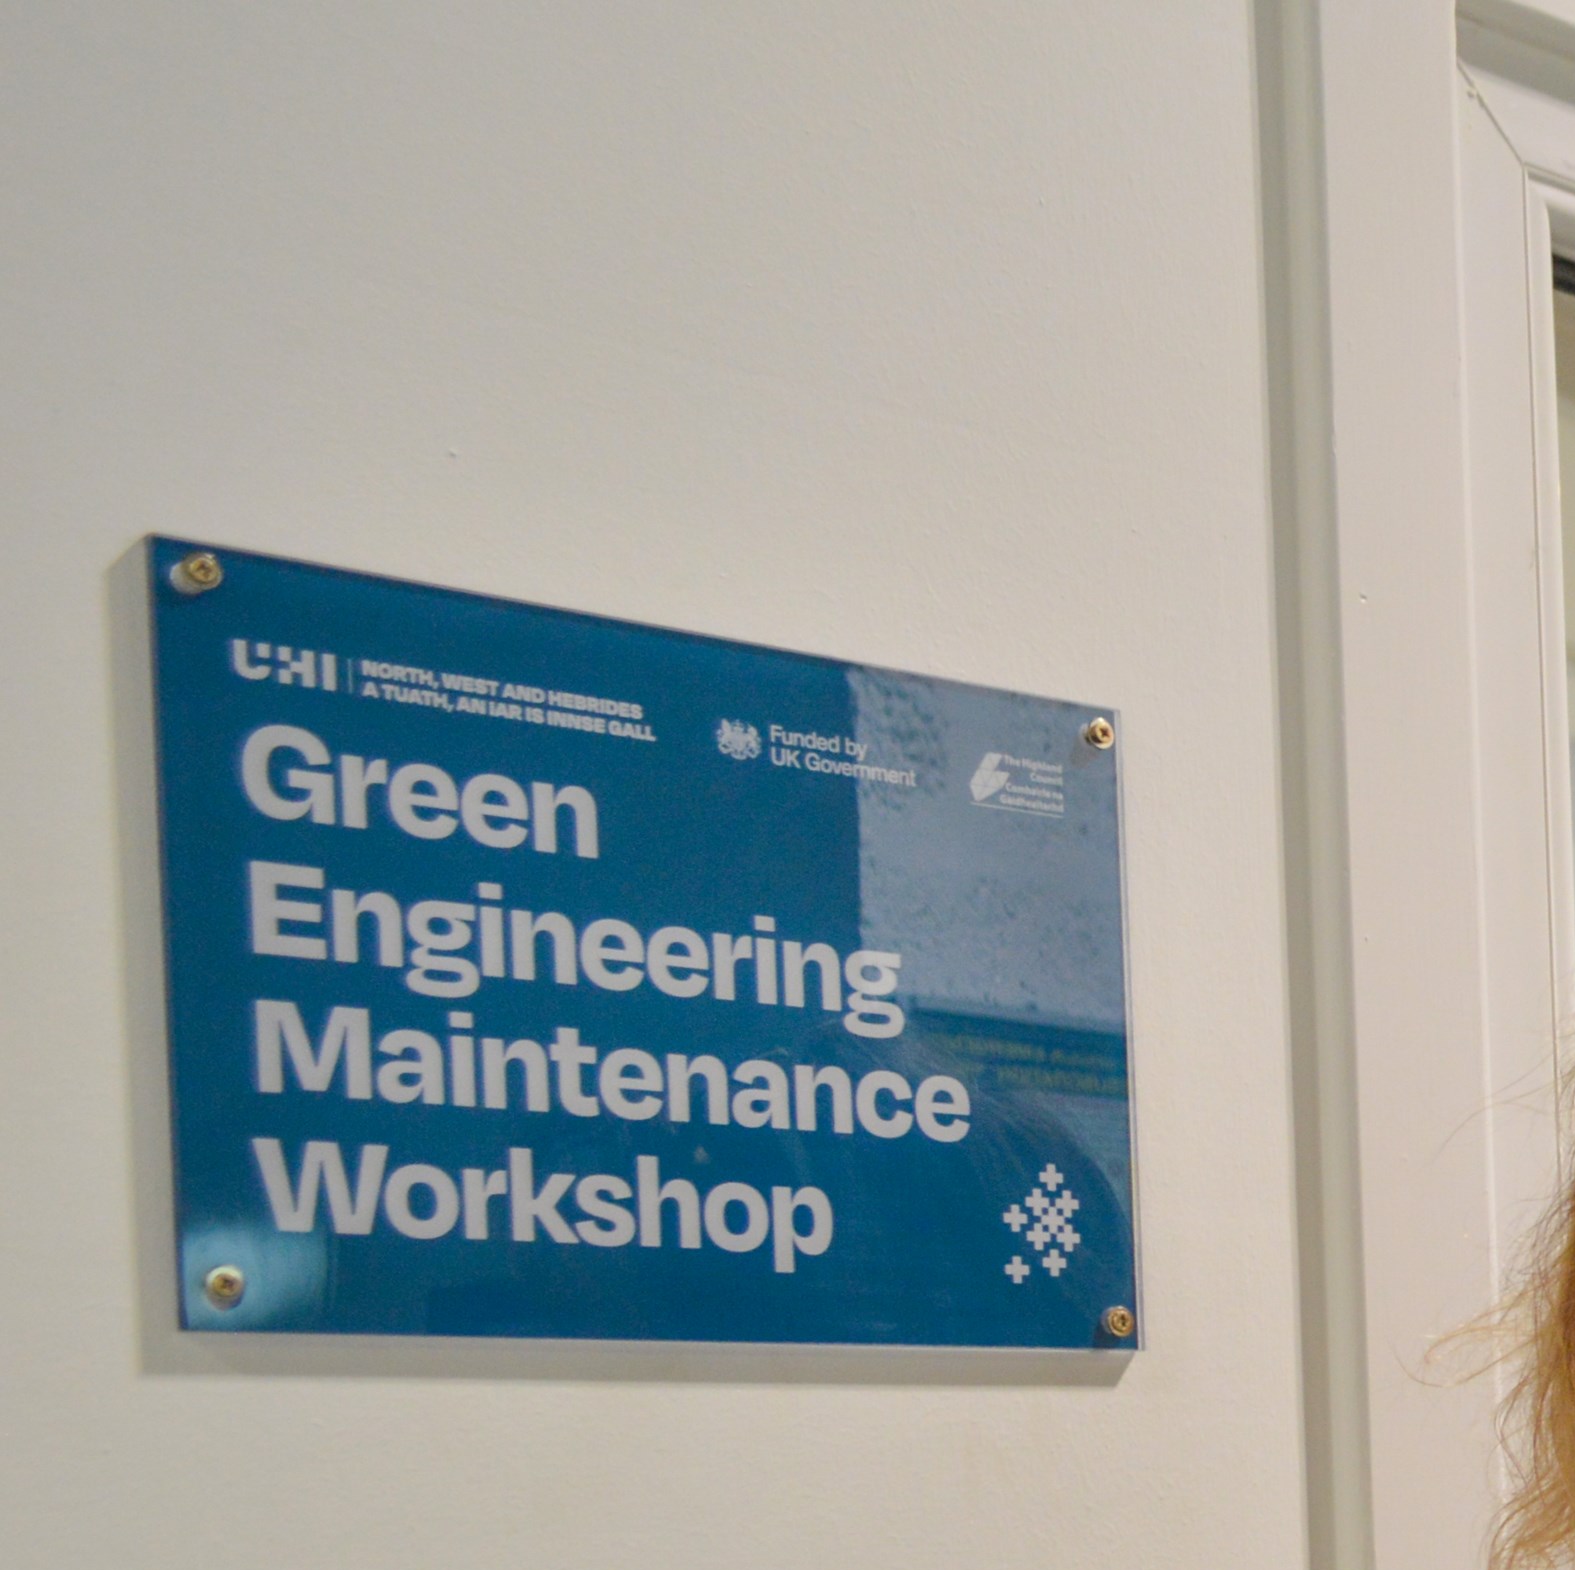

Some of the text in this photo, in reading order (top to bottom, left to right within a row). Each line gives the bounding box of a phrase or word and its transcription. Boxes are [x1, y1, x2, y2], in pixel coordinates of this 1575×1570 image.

[232, 638, 338, 692] UHI
[361, 659, 644, 720] NORTH, WEST AND HEBRIDES
[361, 680, 657, 743] A TUATH, AN IAR IS INNSE GALL
[768, 724, 869, 761] Funded by
[241, 723, 599, 859] Green
[769, 746, 917, 788] UK Government
[247, 859, 905, 1038] Engineering
[252, 999, 972, 1143] Maintenance
[252, 1137, 834, 1273] Workshop
